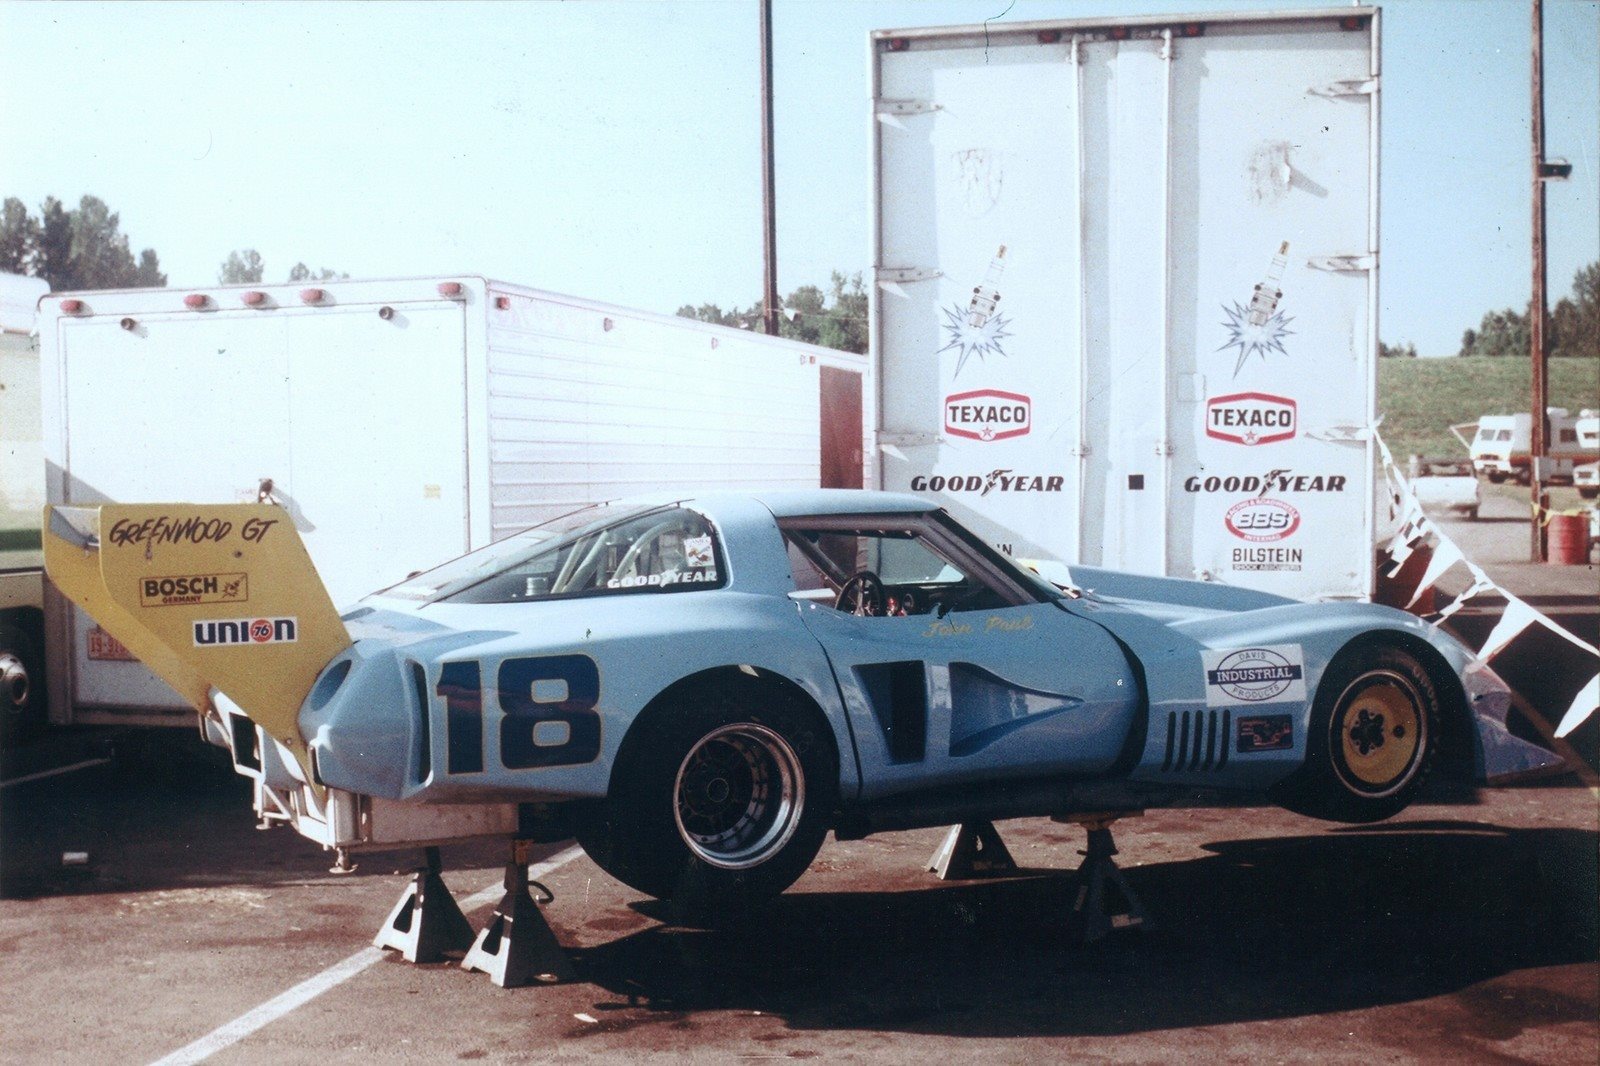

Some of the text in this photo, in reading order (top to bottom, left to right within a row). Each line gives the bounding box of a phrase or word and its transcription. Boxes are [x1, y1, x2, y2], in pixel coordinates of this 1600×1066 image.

[949, 406, 1026, 423] TEXACO
[1211, 408, 1292, 427] TEXACO
[1236, 513, 1290, 529] BBS
[109, 516, 279, 546] GREENWOOD GT
[1232, 548, 1303, 563] BILSTEIN
[144, 576, 219, 598] BOSCH
[162, 595, 201, 604] GERMANY
[252, 624, 270, 638] 76
[1238, 651, 1267, 661] DAVIS
[1216, 667, 1293, 683] INDUSTRIAL
[1232, 684, 1281, 700] PRODUCTS
[436, 653, 602, 775] 18
